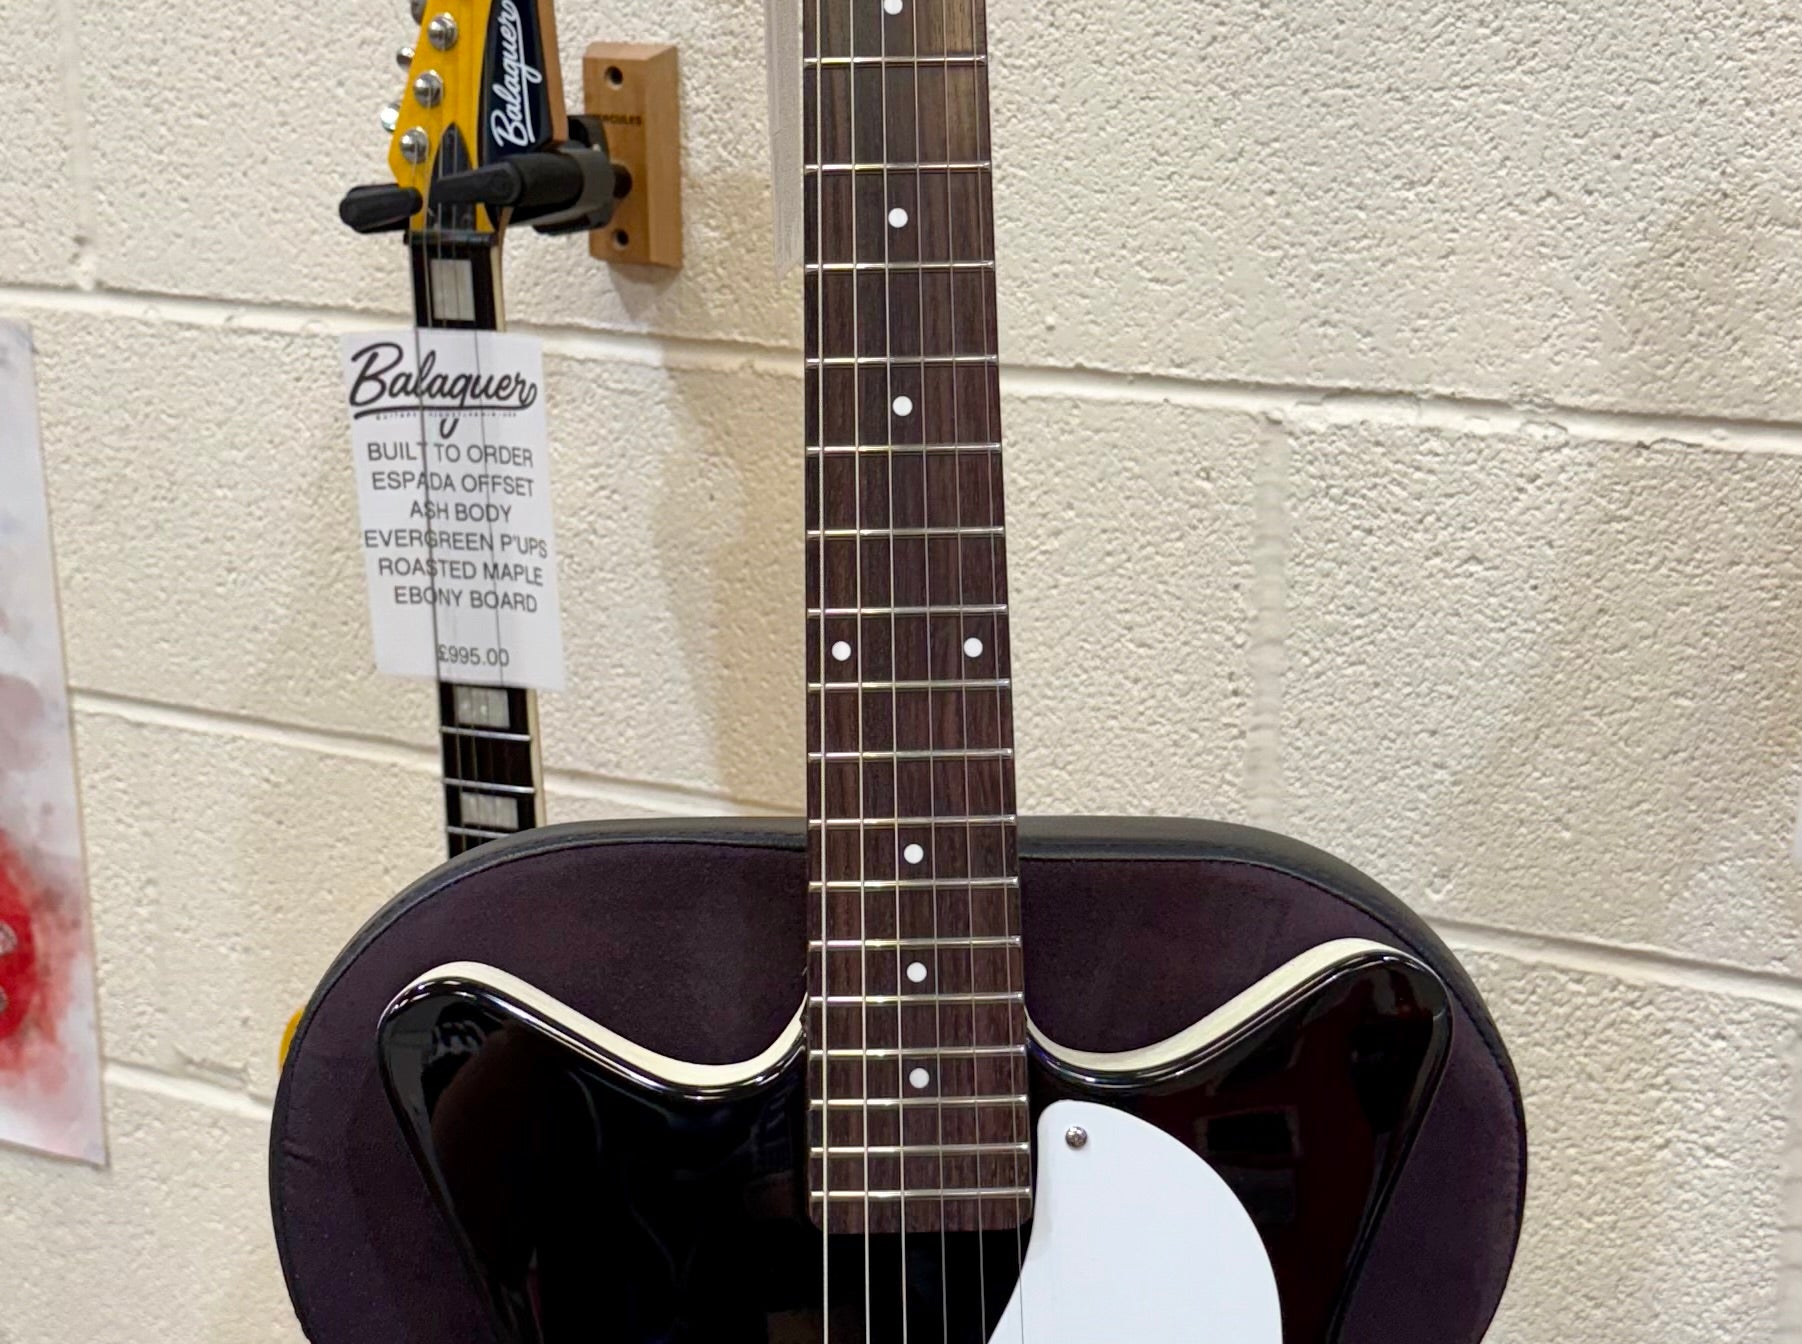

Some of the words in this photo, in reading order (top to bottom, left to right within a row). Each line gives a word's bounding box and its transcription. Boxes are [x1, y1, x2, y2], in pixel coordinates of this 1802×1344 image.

[349, 341, 538, 440] Balaguer
[367, 441, 428, 461] BUILT
[433, 443, 461, 463] TO
[466, 443, 534, 468] ORDER
[372, 470, 456, 492] ESPADA
[461, 473, 535, 497] OFFSET
[410, 500, 449, 520] ASH
[455, 502, 512, 524] BODY
[364, 529, 494, 552] EVERGREEN
[378, 557, 477, 580] ROASTED
[483, 561, 544, 587] MAPLE
[394, 585, 463, 607] EBONY
[470, 589, 538, 613] BOARD
[437, 643, 510, 668] £995.00
